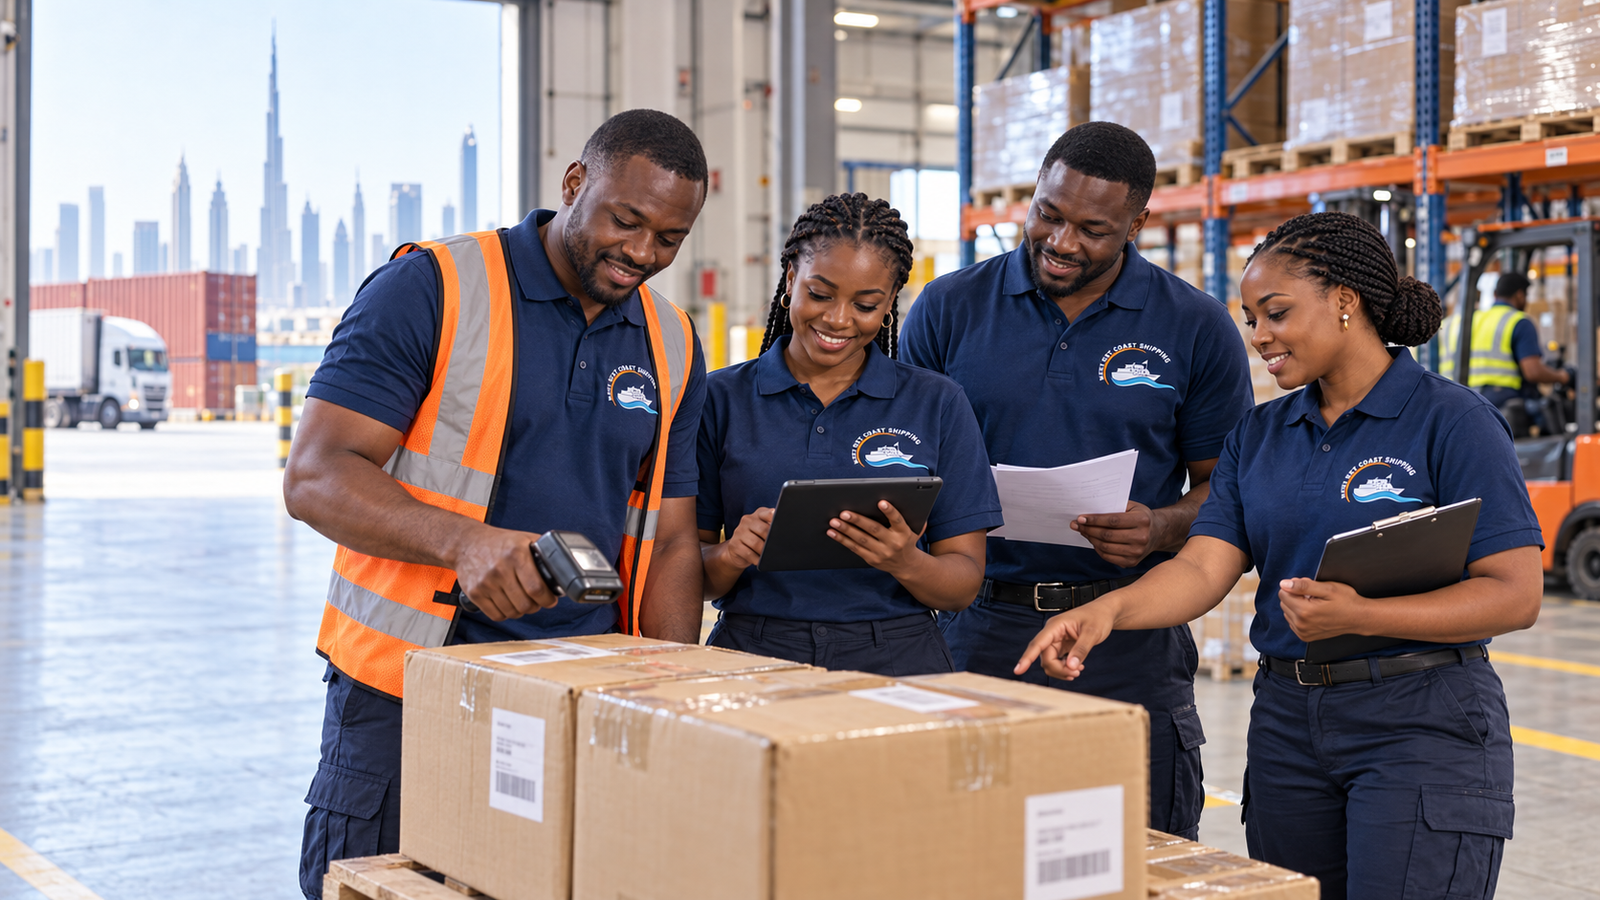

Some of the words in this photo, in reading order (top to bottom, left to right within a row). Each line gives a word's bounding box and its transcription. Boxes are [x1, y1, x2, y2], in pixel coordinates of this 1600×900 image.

[1113, 342, 1137, 352] COAST
[1139, 343, 1171, 364] SHIPPING
[862, 427, 886, 438] COAST
[888, 427, 922, 445] SHIPPING
[1358, 456, 1383, 468] COAST
[1384, 456, 1417, 476] SHIPPING
